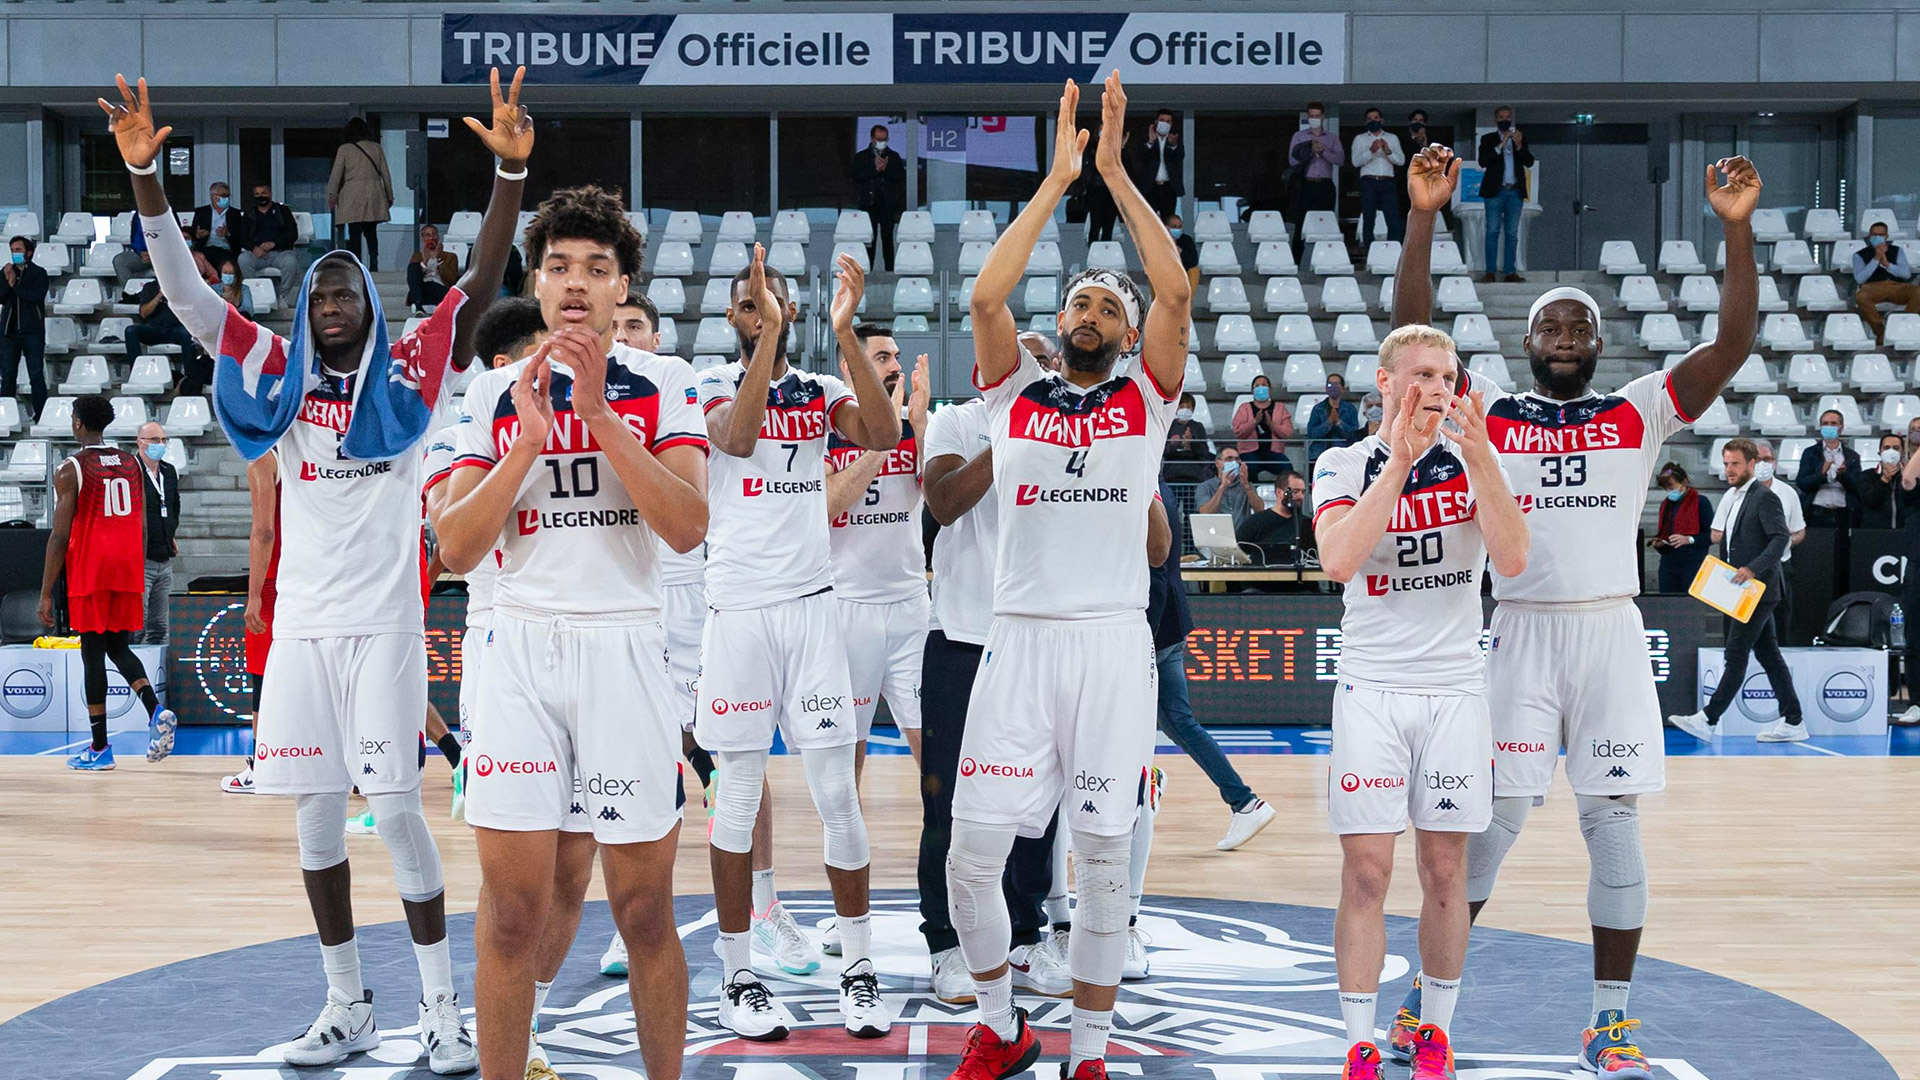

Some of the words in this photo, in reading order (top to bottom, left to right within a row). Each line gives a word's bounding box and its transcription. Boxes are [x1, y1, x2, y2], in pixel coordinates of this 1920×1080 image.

[454, 32, 655, 66] TRIBUNE
[678, 31, 870, 67] Officielle
[904, 31, 1106, 64] TRIBUNE
[1129, 31, 1323, 66] Officielle
[931, 131, 957, 148] H2
[301, 400, 352, 432] NAN
[763, 409, 824, 438] NTES
[1024, 407, 1128, 446] NANTES
[498, 413, 646, 456] NNTS
[1504, 423, 1620, 451] NANTES
[781, 444, 798, 472] 7
[833, 450, 914, 473] NAES
[1065, 451, 1088, 478] 4
[318, 461, 391, 479] LEGENDRE
[545, 457, 600, 499] 10
[1541, 455, 1587, 487] 33
[103, 478, 132, 517] 10
[865, 480, 880, 505] 5
[1040, 488, 1128, 503] LEGENDRE
[1536, 495, 1616, 510] LEGENDRE
[542, 509, 638, 529] LEGENDRE
[850, 512, 909, 525] LEGENDRE
[1392, 491, 1471, 529] NTES
[1396, 531, 1443, 567] 20
[1392, 570, 1473, 592] LEGENDRE
[1186, 629, 1304, 680] SKET
[5, 687, 44, 695] VOLVO
[1825, 690, 1866, 698] VOLVO
[731, 699, 772, 712] VEOLIA
[801, 697, 842, 712] idex
[269, 746, 323, 757] VEOLIA
[360, 736, 385, 755] dex
[1497, 741, 1545, 753] VEOLIA
[1592, 740, 1639, 758] idex
[497, 761, 557, 774] VEOLIA
[979, 763, 1034, 778] VEOLIA
[1073, 770, 1111, 793] dex
[1364, 777, 1405, 789] VEOLIA
[1424, 770, 1469, 790] idex
